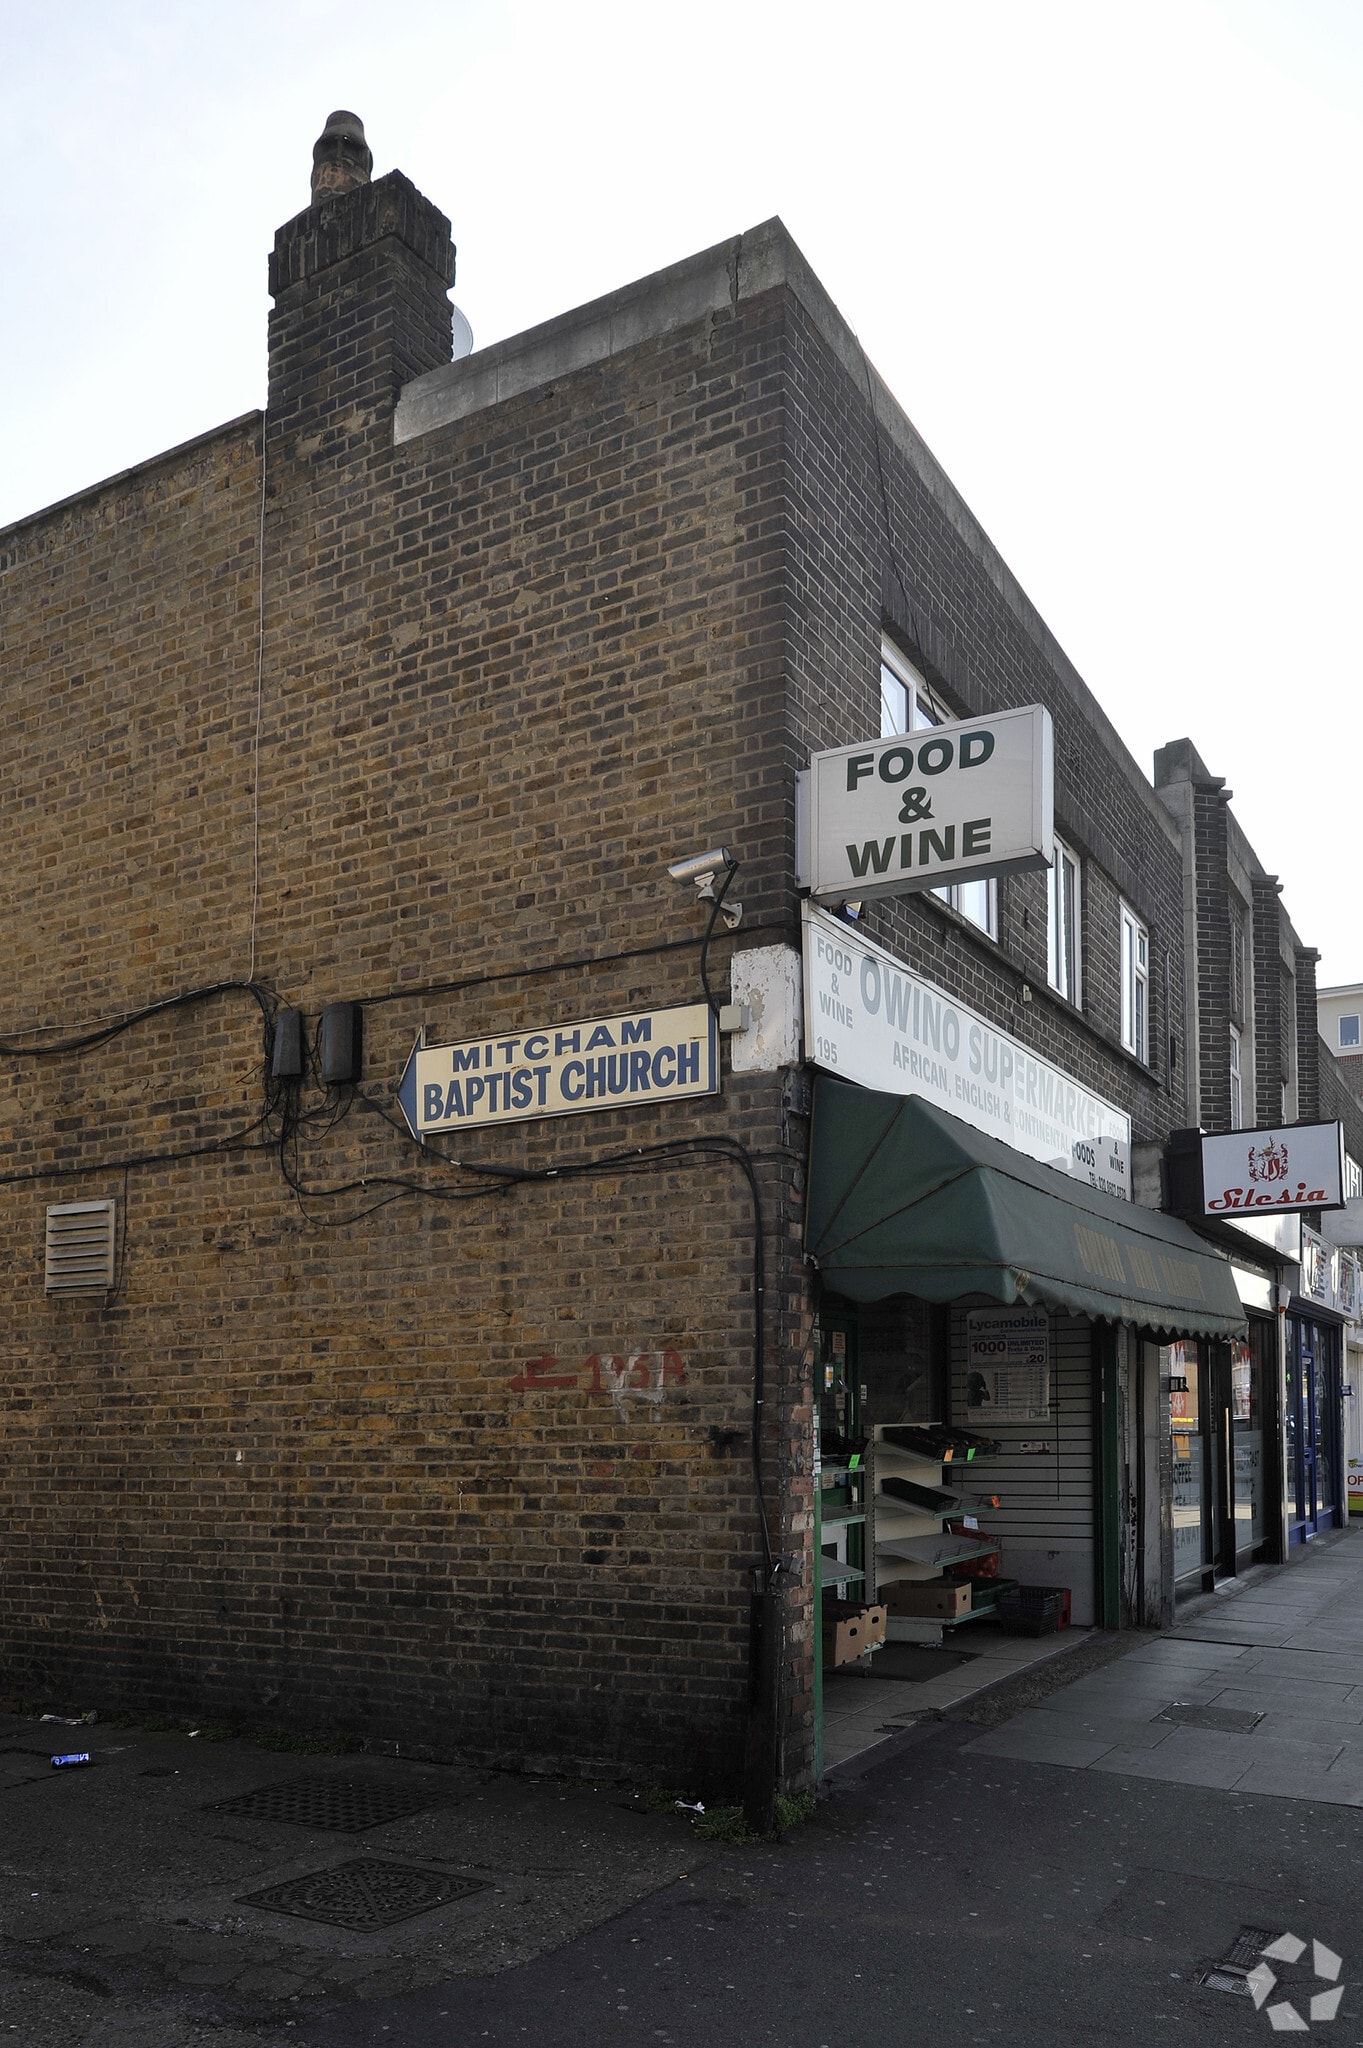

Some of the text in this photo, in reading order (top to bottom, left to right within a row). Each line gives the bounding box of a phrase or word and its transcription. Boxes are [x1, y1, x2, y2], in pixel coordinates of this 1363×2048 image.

[846, 730, 995, 791] FOOD
[898, 787, 935, 823] &
[846, 818, 992, 878] WINE
[817, 937, 852, 976] FOOD
[831, 973, 839, 996] &
[819, 991, 853, 1029] WINE
[452, 1017, 652, 1073] MITCHAM
[817, 1036, 838, 1064] 195
[860, 955, 1104, 1144] OWINO SUPERMARKET
[424, 1041, 700, 1122] BAPTIST CHURCH
[893, 1041, 1095, 1168] AFRICAN, ENGLISH & CONTINENTAL FOODS
[1109, 1155, 1124, 1174] WINE
[1114, 1142, 1119, 1155] &
[1208, 1181, 1329, 1210] Silesia
[969, 1317, 1047, 1332] Lycamobile
[972, 1341, 1007, 1353] 1000
